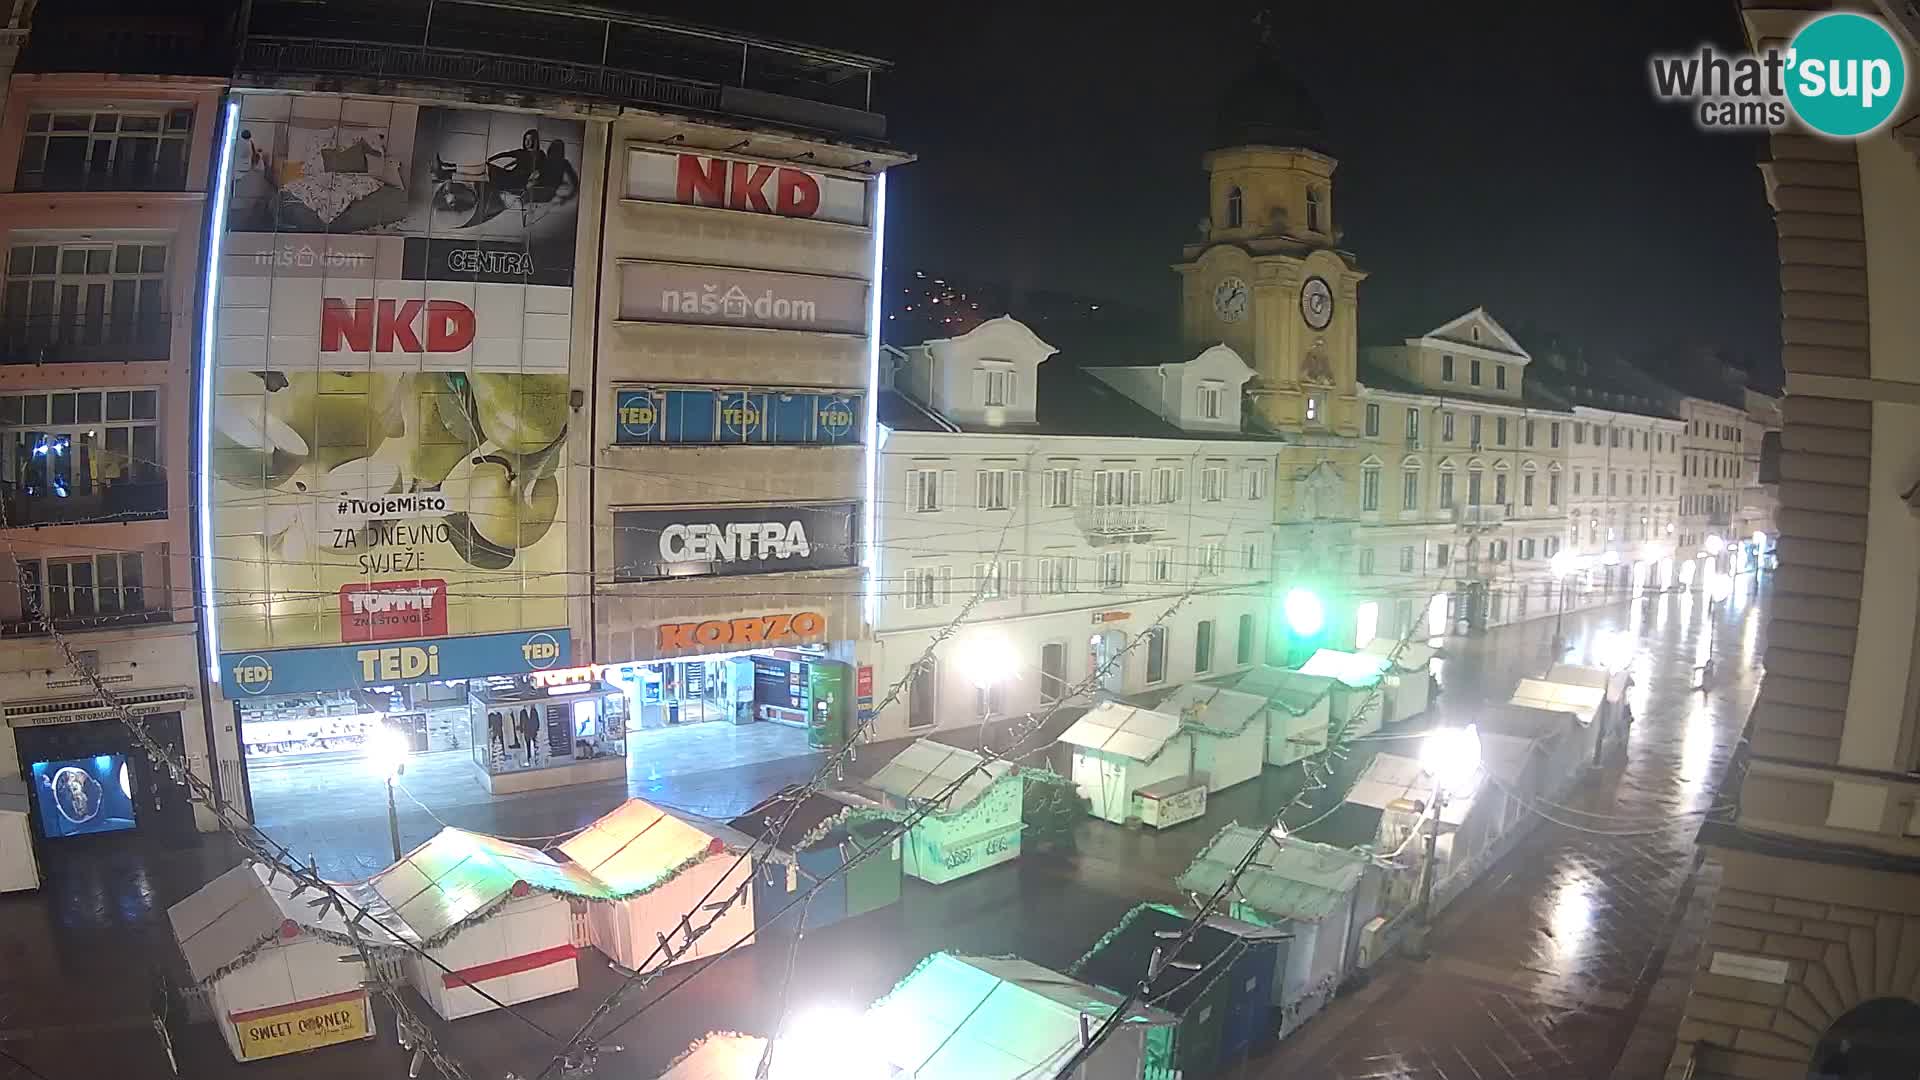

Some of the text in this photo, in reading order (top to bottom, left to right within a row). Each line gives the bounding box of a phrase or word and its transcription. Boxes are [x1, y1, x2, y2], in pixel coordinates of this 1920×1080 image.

[676, 154, 820, 217] NKD
[448, 249, 534, 275] CENTRA
[661, 284, 816, 322] naš dom
[320, 297, 477, 353] NKD
[337, 496, 446, 516] #TvojeMisto
[333, 523, 450, 549] ZA DNEVNO
[659, 520, 811, 563] CENTRA
[359, 547, 425, 575] SVJEŽE
[348, 585, 438, 614] TOMMY
[659, 612, 827, 650] KORZO
[356, 645, 439, 682] TEDi
[521, 643, 560, 660] TEDi
[233, 667, 272, 684] TEDi
[249, 1021, 293, 1041] SWEET
